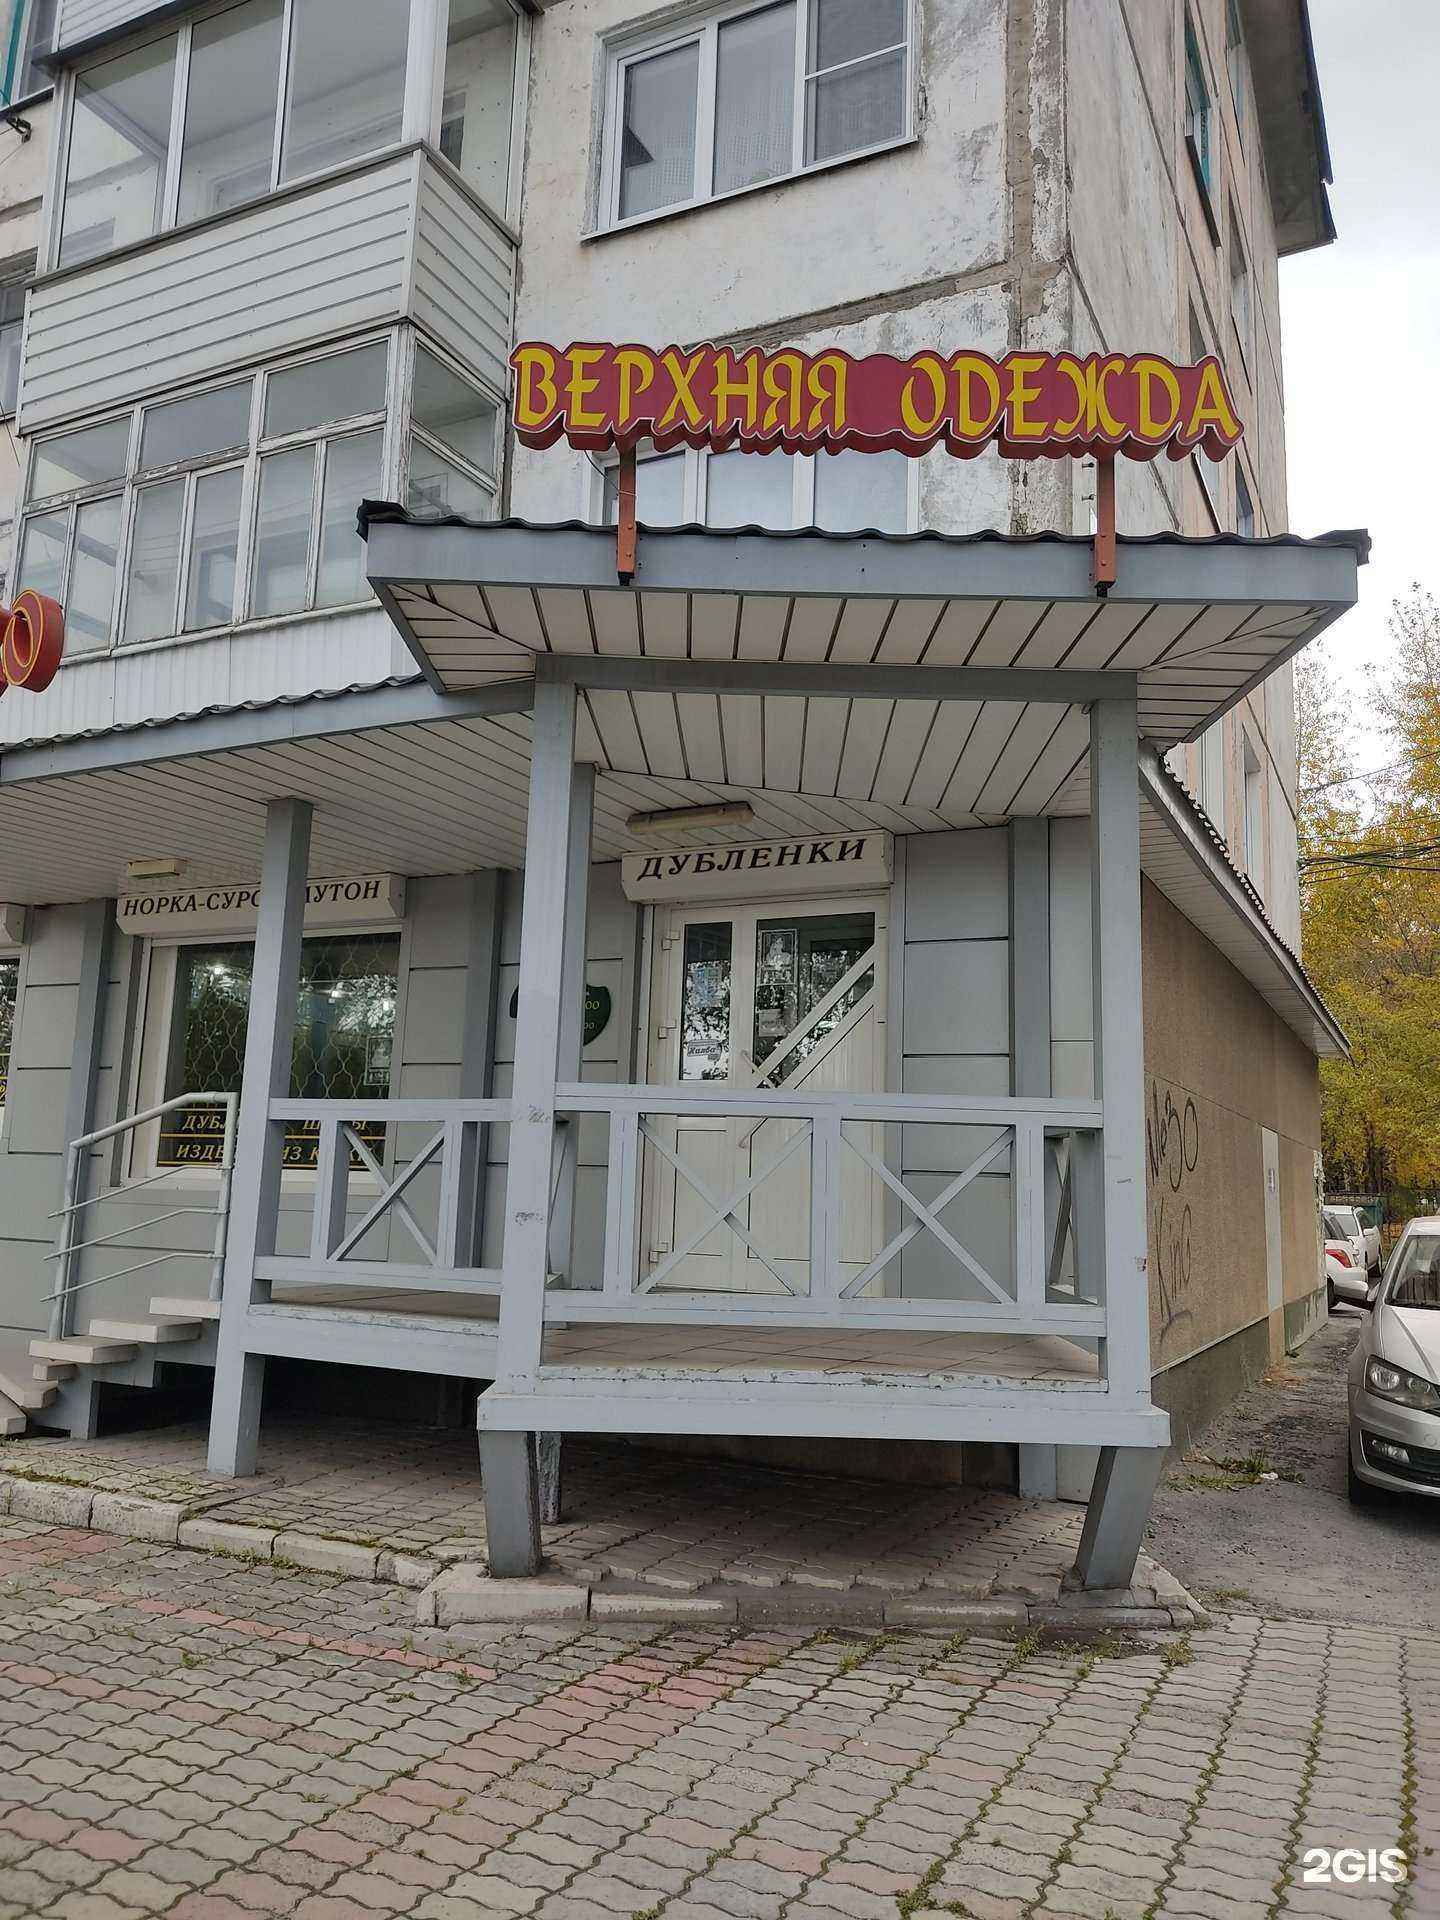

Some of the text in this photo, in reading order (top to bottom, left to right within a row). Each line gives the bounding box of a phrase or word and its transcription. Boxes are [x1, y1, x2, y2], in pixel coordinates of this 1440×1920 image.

[512, 348, 1241, 440] ВЕРХНЯЯ ОДЕЖДА
[637, 838, 868, 882] ДУБЛЕНКИ
[124, 889, 260, 917] НОРКА-СУРО
